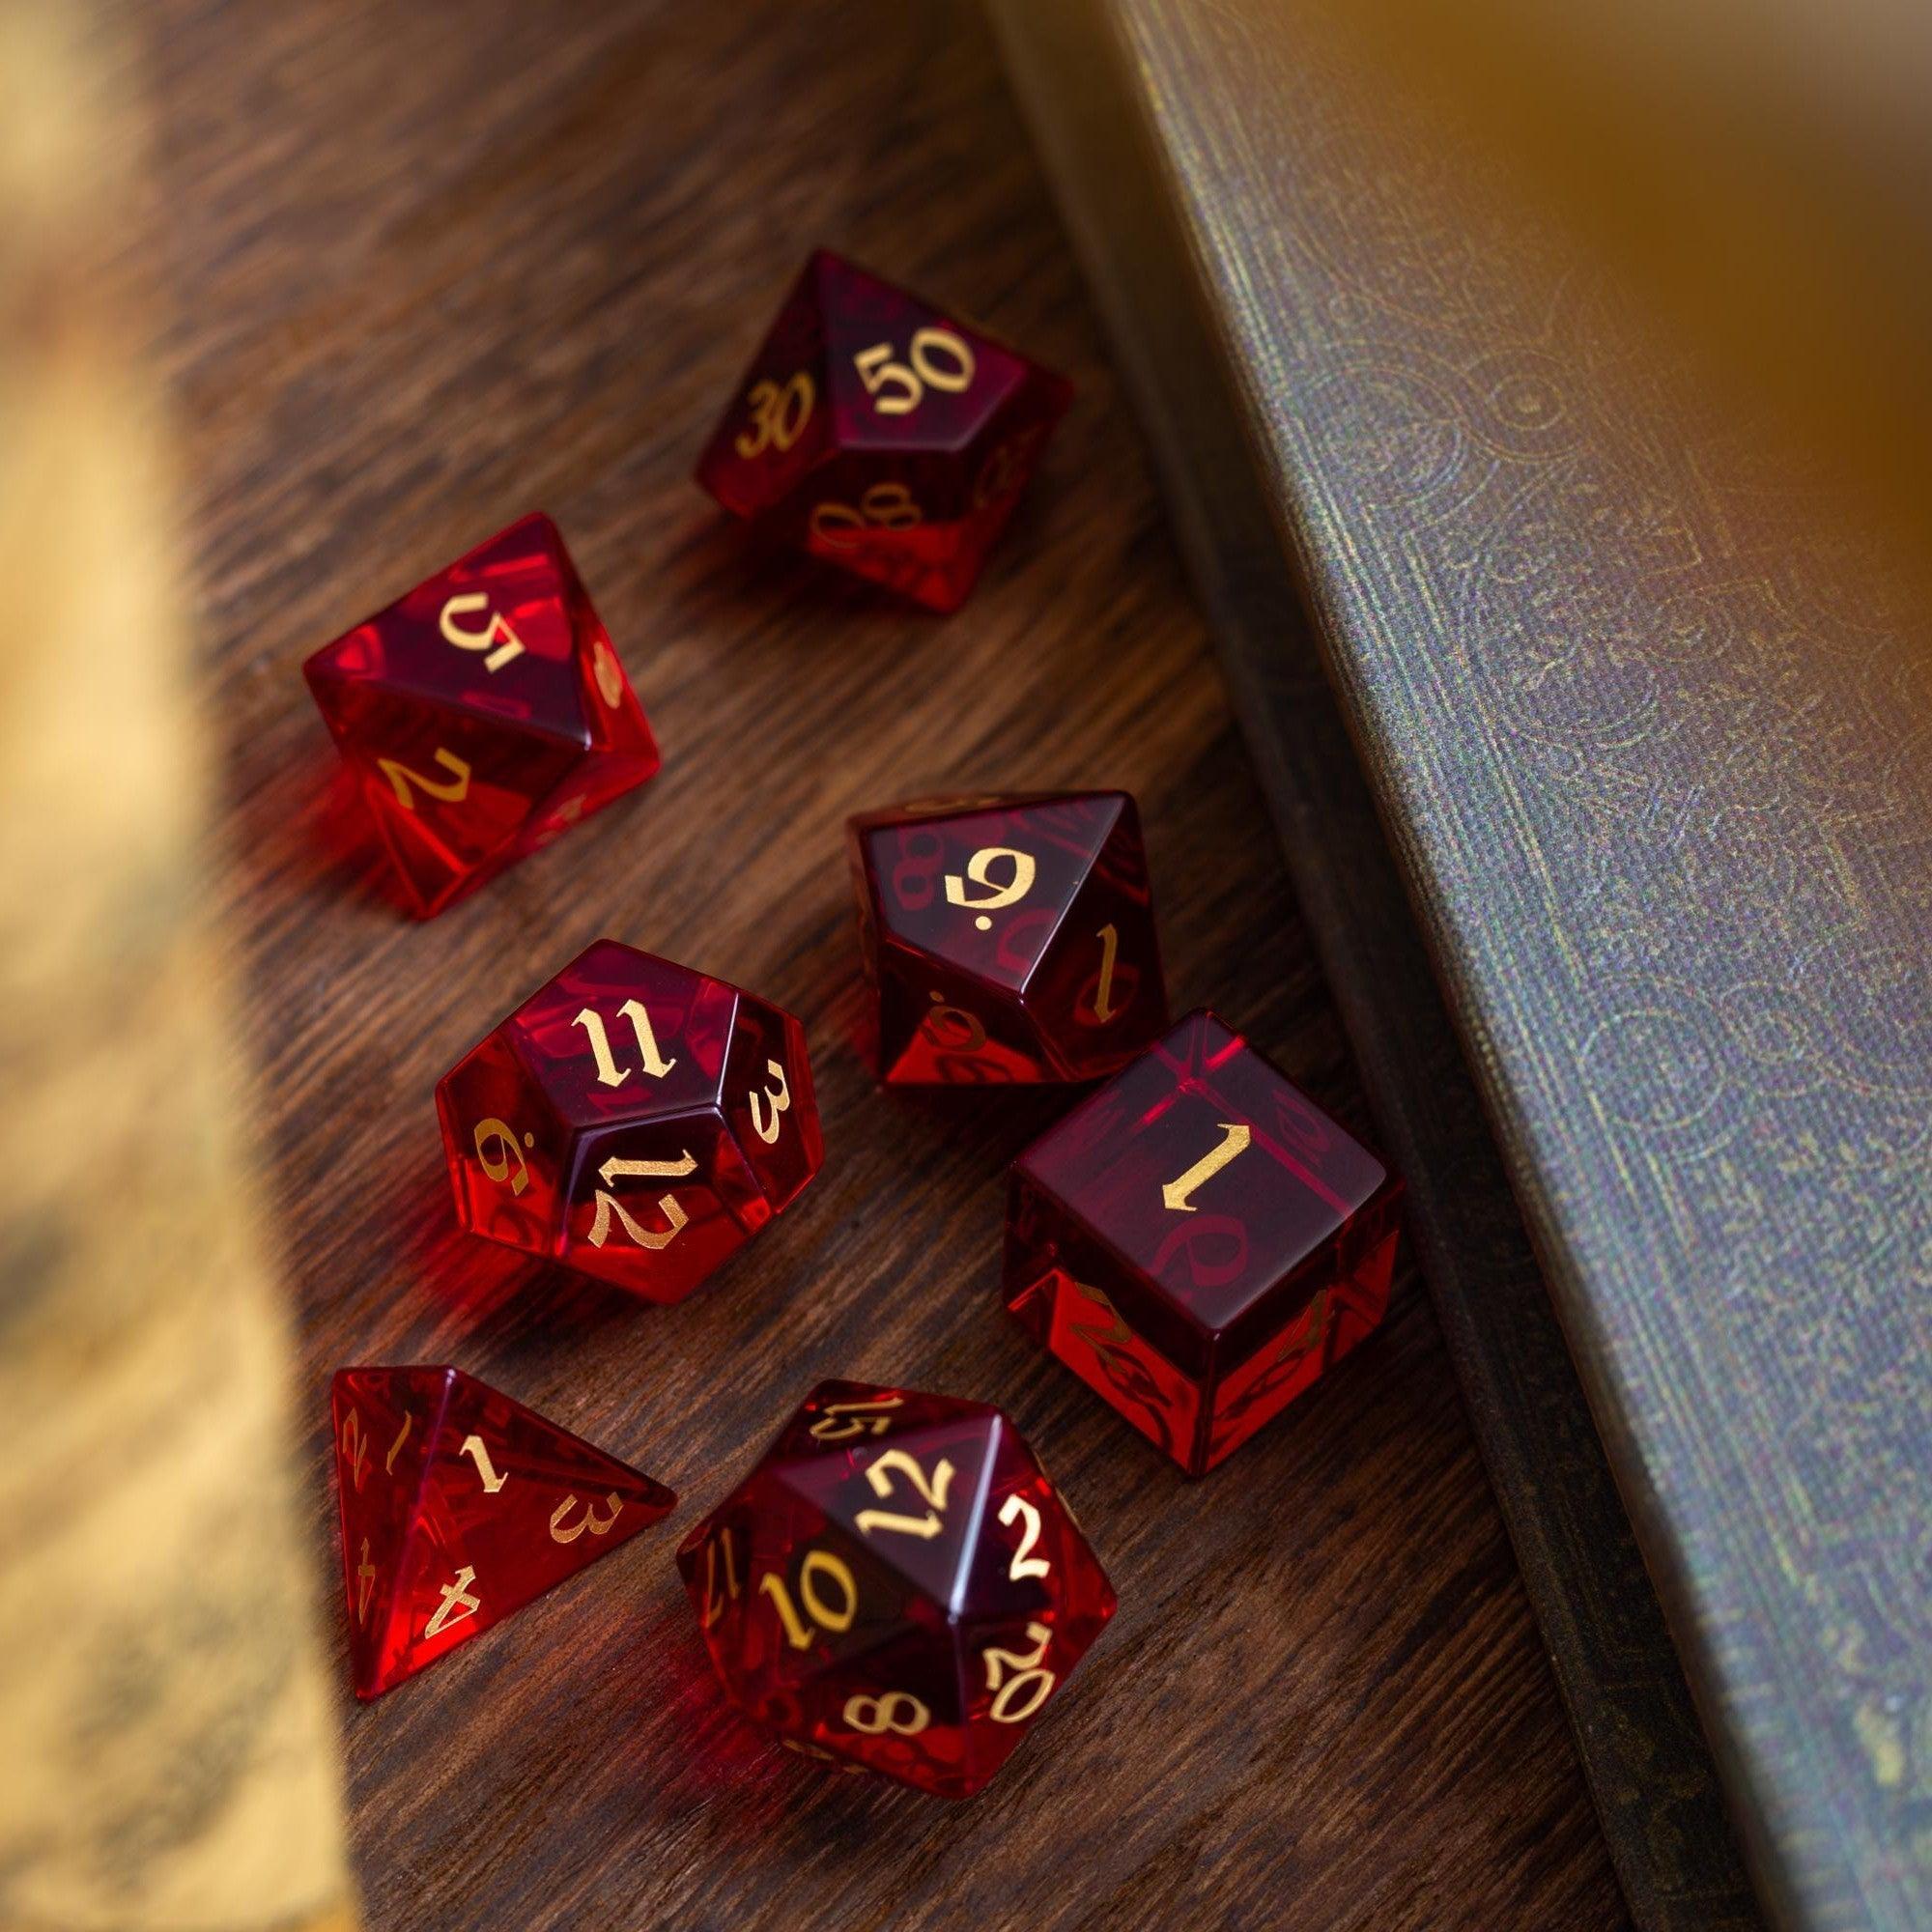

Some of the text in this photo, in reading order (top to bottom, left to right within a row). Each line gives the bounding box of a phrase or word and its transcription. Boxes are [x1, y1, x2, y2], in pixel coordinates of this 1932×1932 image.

[856, 327, 976, 413] 50
[736, 371, 815, 459] 30
[439, 592, 526, 674] 5
[377, 747, 471, 810] 2
[1095, 923, 1119, 1024] 1
[571, 999, 677, 1088] 11
[749, 1059, 791, 1145] 3
[587, 1149, 699, 1250] 12
[1161, 1122, 1251, 1212] 1
[810, 1396, 905, 1441] 15
[459, 1435, 509, 1493] 1
[854, 1448, 956, 1540] 12
[549, 1492, 624, 1545] 3
[998, 1493, 1051, 1582] 2
[424, 1565, 481, 1639] 4
[758, 1549, 858, 1650] 10
[842, 1690, 930, 1736] 8
[982, 1621, 1056, 1724] 20
